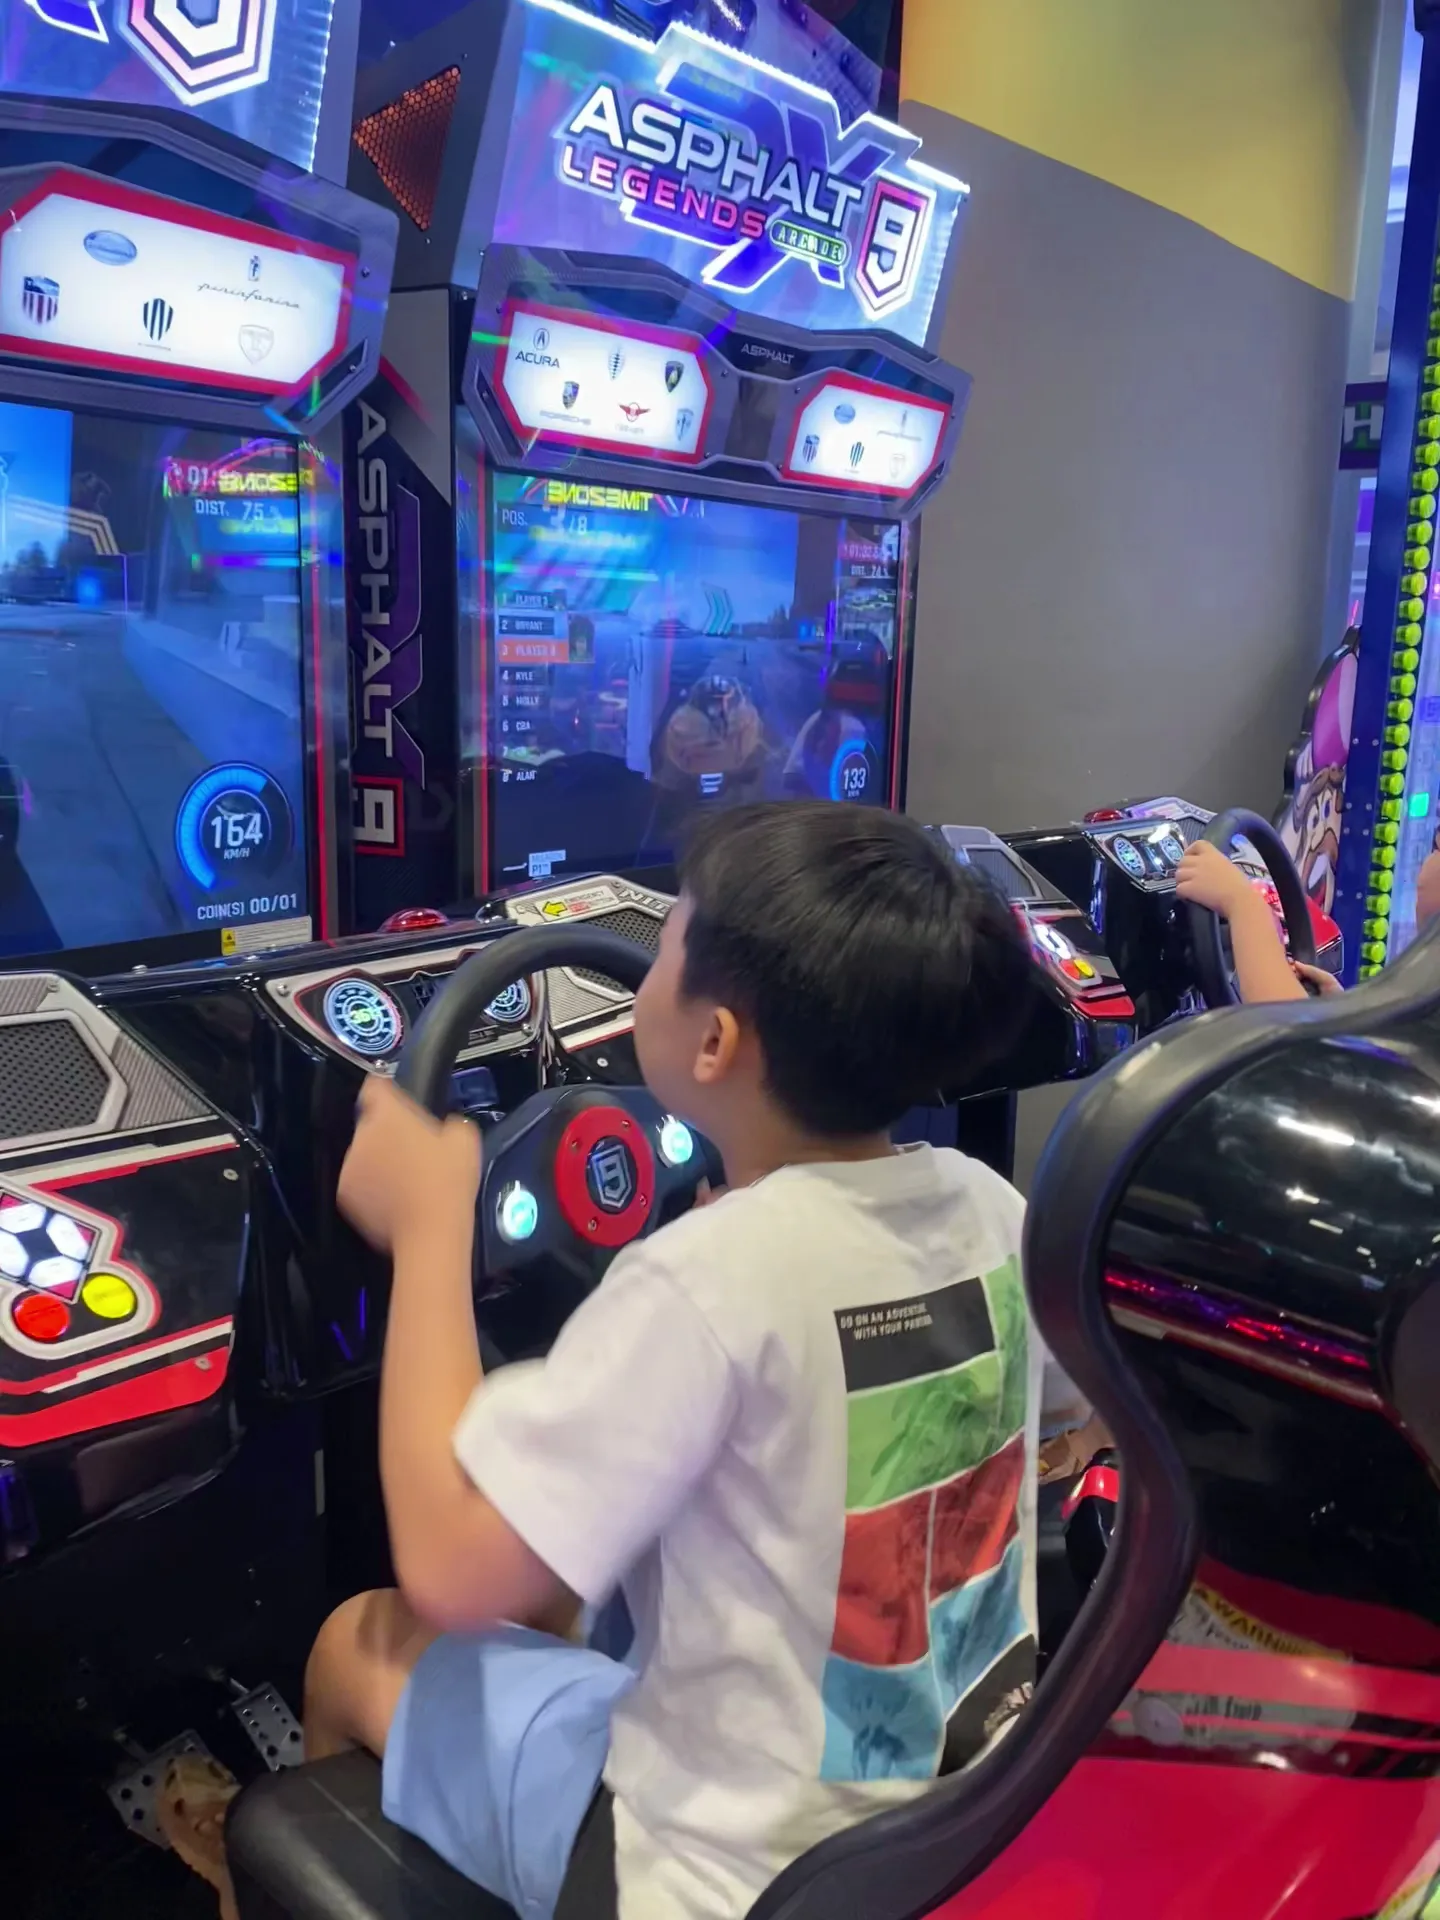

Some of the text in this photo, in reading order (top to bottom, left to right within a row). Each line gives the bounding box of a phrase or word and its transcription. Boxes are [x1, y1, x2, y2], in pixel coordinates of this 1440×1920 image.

[569, 86, 863, 227] ASPHALT
[562, 145, 767, 238] LEGENDS
[778, 225, 840, 261] ARCADE
[515, 350, 560, 369] ACURA
[741, 343, 795, 365] ASPHALT
[195, 499, 229, 516] DIST.
[242, 501, 264, 520] 75
[502, 508, 528, 526] POS.
[357, 399, 393, 758] ASPHALT
[502, 620, 508, 631] 2
[502, 670, 534, 682] 4 KYLE
[844, 767, 867, 791] 133
[211, 812, 263, 849] 164
[223, 847, 250, 861] KM/H
[250, 893, 297, 915] 00/01
[853, 1325, 878, 1341] WITH
[878, 1321, 903, 1337] YOUR
